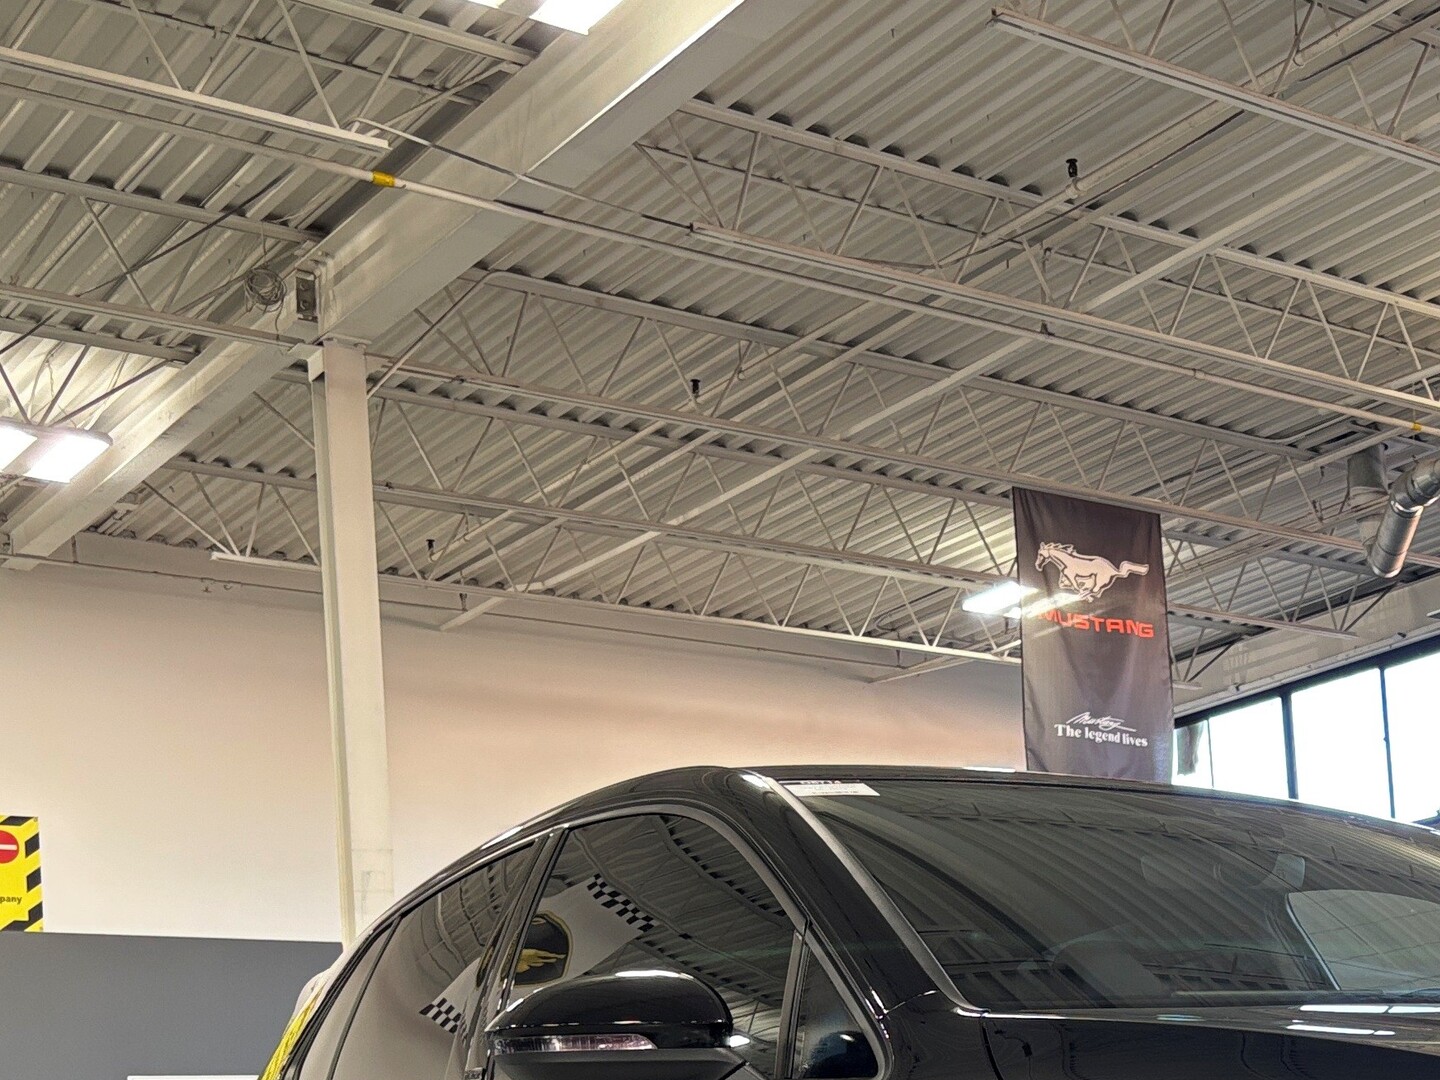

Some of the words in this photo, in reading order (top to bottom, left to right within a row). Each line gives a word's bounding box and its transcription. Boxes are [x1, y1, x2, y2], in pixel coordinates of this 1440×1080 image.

[1038, 608, 1154, 638] MUSTANG
[1054, 723, 1082, 738] The
[1084, 726, 1121, 744] legend
[1122, 732, 1149, 748] lives
